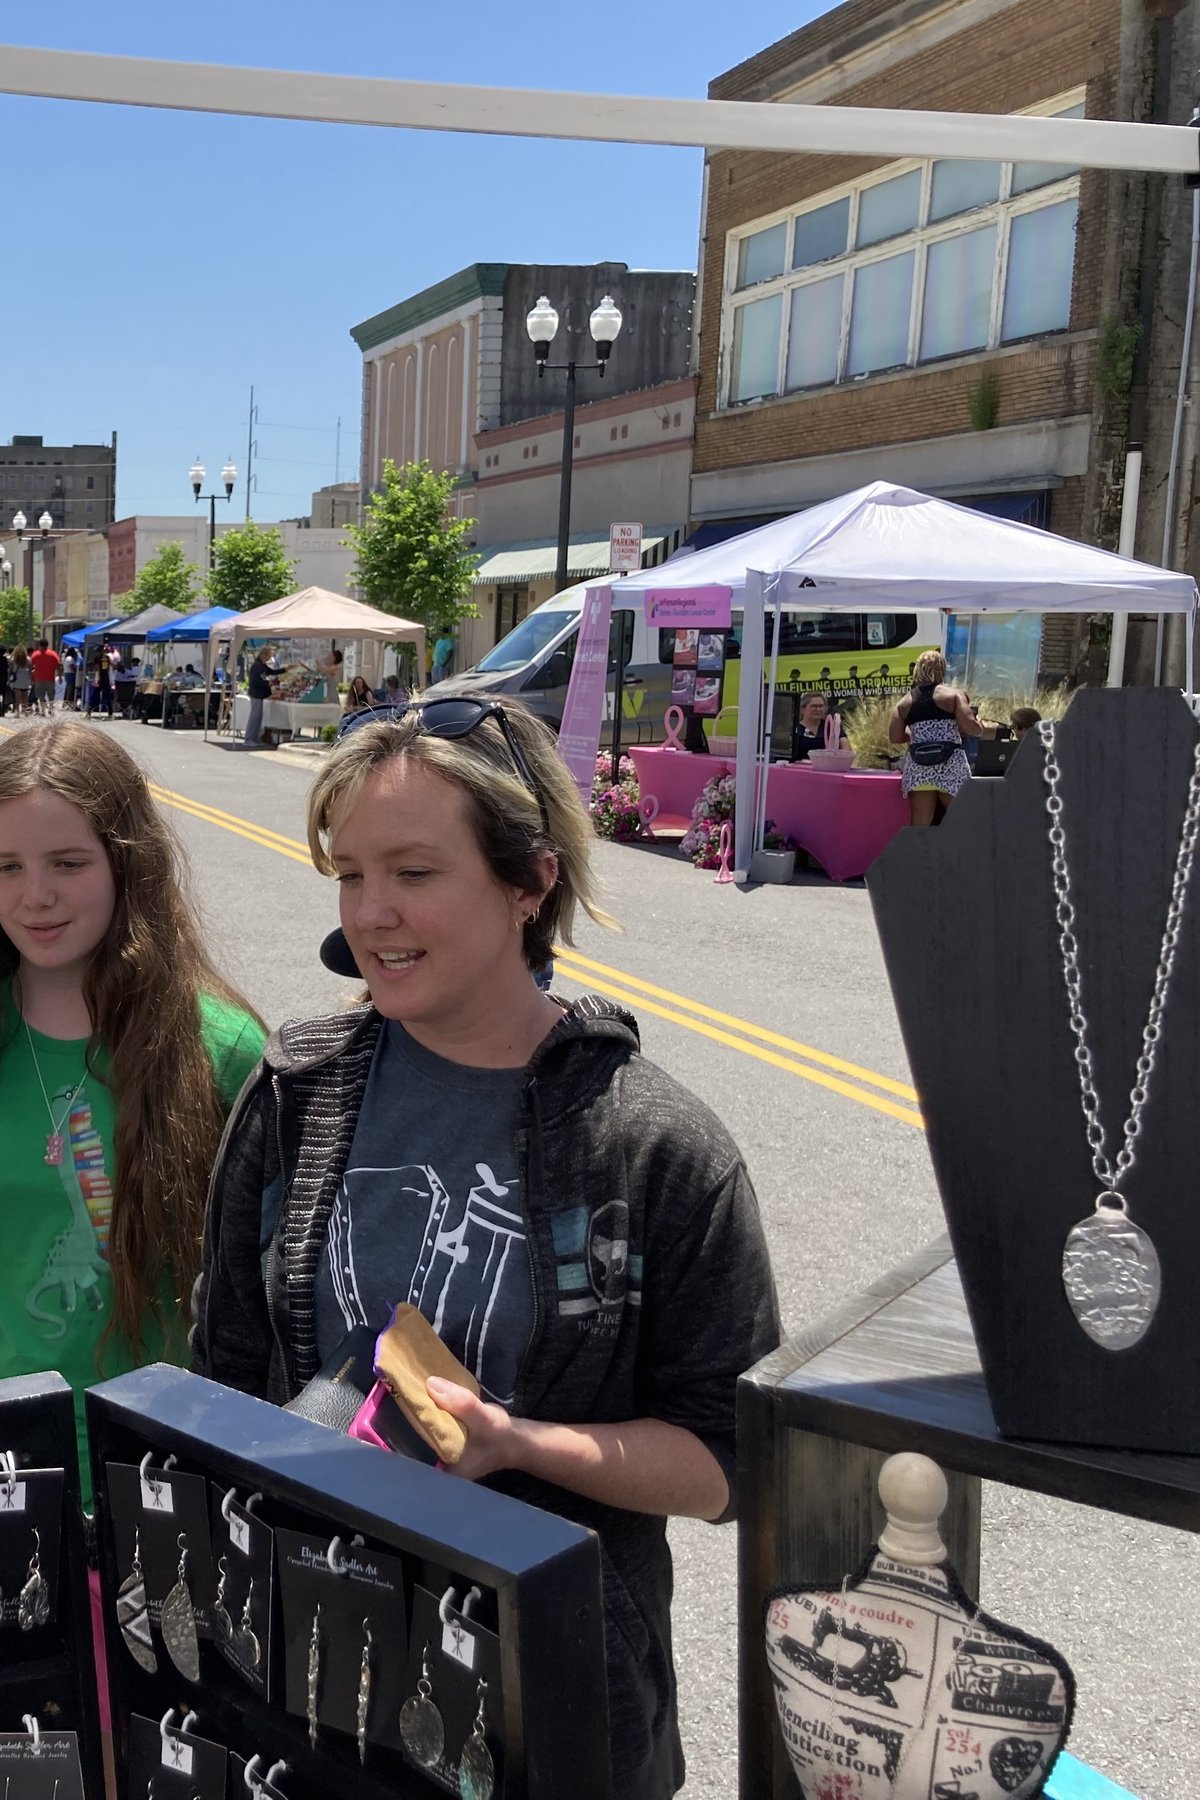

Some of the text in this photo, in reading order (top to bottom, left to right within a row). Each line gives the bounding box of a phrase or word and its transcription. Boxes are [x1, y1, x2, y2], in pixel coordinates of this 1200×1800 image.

[620, 527, 632, 537] NO
[612, 538, 639, 547] PARKING
[775, 676, 914, 693] ULFILLING OUR PROMISES
[834, 688, 863, 698] WOMEN
[865, 687, 882, 696] WHO
[884, 686, 912, 695] SERVED
[339, 1557, 363, 1572] Sadler
[859, 1608, 915, 1629] coudre
[963, 1696, 1033, 1717] Chanvre
[779, 1694, 860, 1756] Stenciling
[54, 1740, 71, 1750] Art
[945, 1738, 982, 1757] 254
